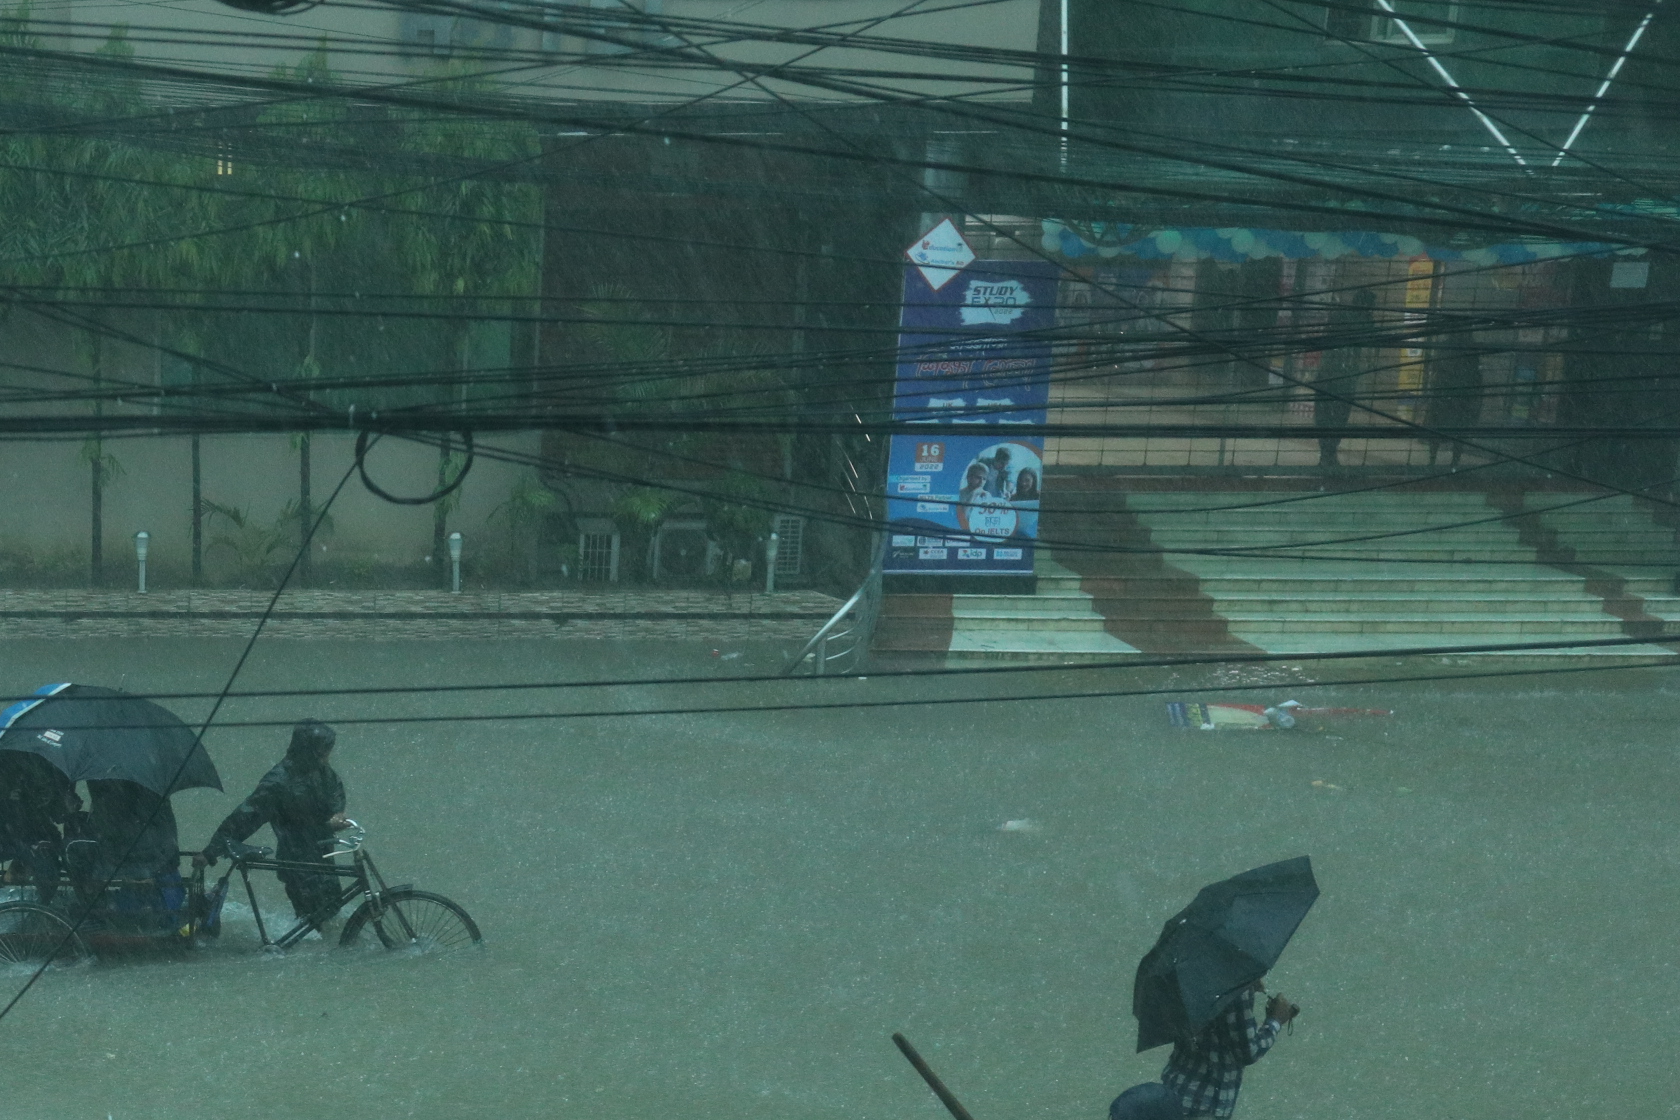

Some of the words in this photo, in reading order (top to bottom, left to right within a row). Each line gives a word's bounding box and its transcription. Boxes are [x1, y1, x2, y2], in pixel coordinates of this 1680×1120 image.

[972, 286, 1018, 296] STUDY
[922, 444, 940, 456] 16
[975, 527, 986, 535] On
[987, 527, 1010, 536] IELTS
